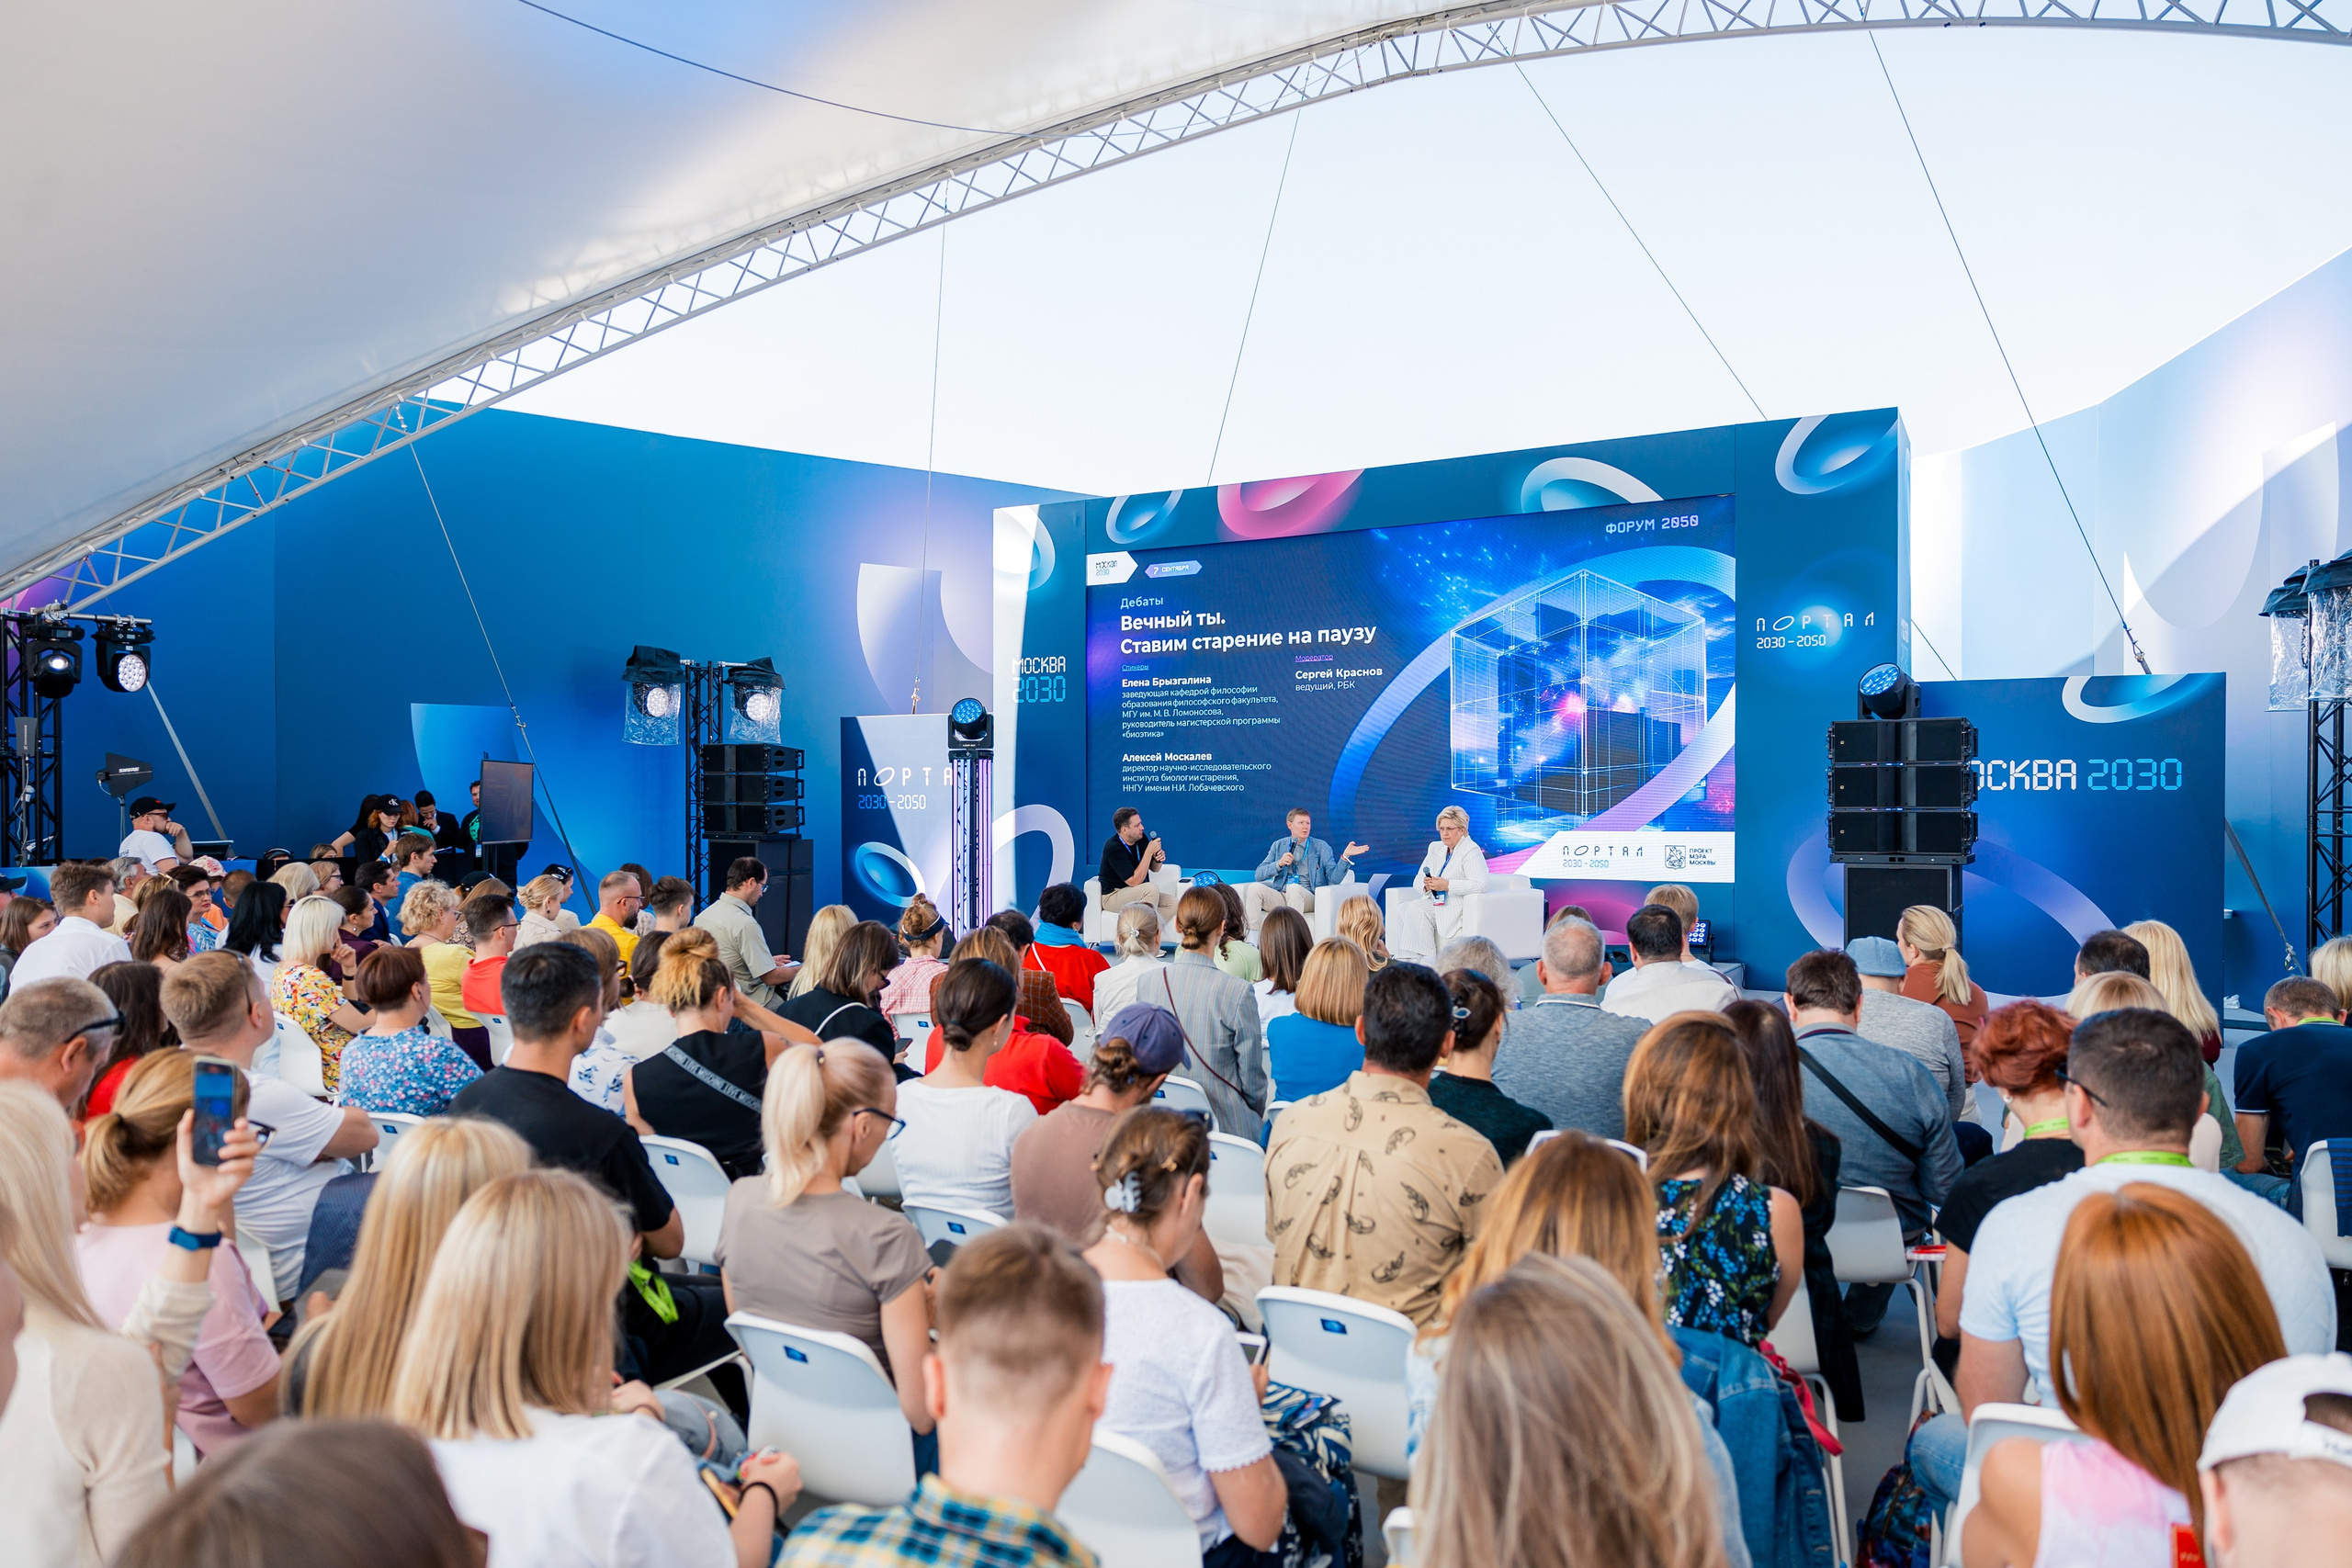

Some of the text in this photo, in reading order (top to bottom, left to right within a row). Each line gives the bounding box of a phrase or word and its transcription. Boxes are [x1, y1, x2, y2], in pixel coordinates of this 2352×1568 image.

[1606, 514, 1699, 534] ФОРУМ 2050
[1153, 564, 1190, 575] 7 СЕНТЯБРЯ
[1120, 596, 1164, 610] Дебаты
[1121, 610, 1227, 631] Вечный ты.
[1120, 626, 1377, 654] Ставим старение на паузу
[1295, 654, 1334, 662] Модератор
[1012, 656, 1066, 674] МОСКВА
[1122, 663, 1149, 671] Спикеры
[1295, 668, 1383, 681] Сергей Краснов
[1122, 675, 1212, 688] Елена Брызгалина
[1295, 681, 1356, 693] ведущий, РБК
[1012, 675, 1066, 704] 2030
[1122, 685, 1258, 699] заведующая кафедрой философии
[1122, 695, 1279, 709] образования философского факультета,
[1122, 710, 1138, 718] МГУ
[1153, 709, 1163, 717] М.
[1163, 709, 1171, 717] В.
[1172, 707, 1224, 717] Ломоносова,
[1122, 716, 1281, 730] руководитель магистерской программы
[1122, 729, 1164, 739] «биоэтика»
[1122, 752, 1213, 762] Алексей Москалев
[1122, 762, 1272, 773] директор научно-исследовательского
[857, 766, 953, 786] ПОРТА
[1123, 773, 1239, 783] института биологии старения,
[2087, 758, 2182, 791] 2030
[1123, 784, 1144, 793] ННГУ
[1171, 784, 1187, 792] Н.И.
[1188, 783, 1245, 793] Лобачевского
